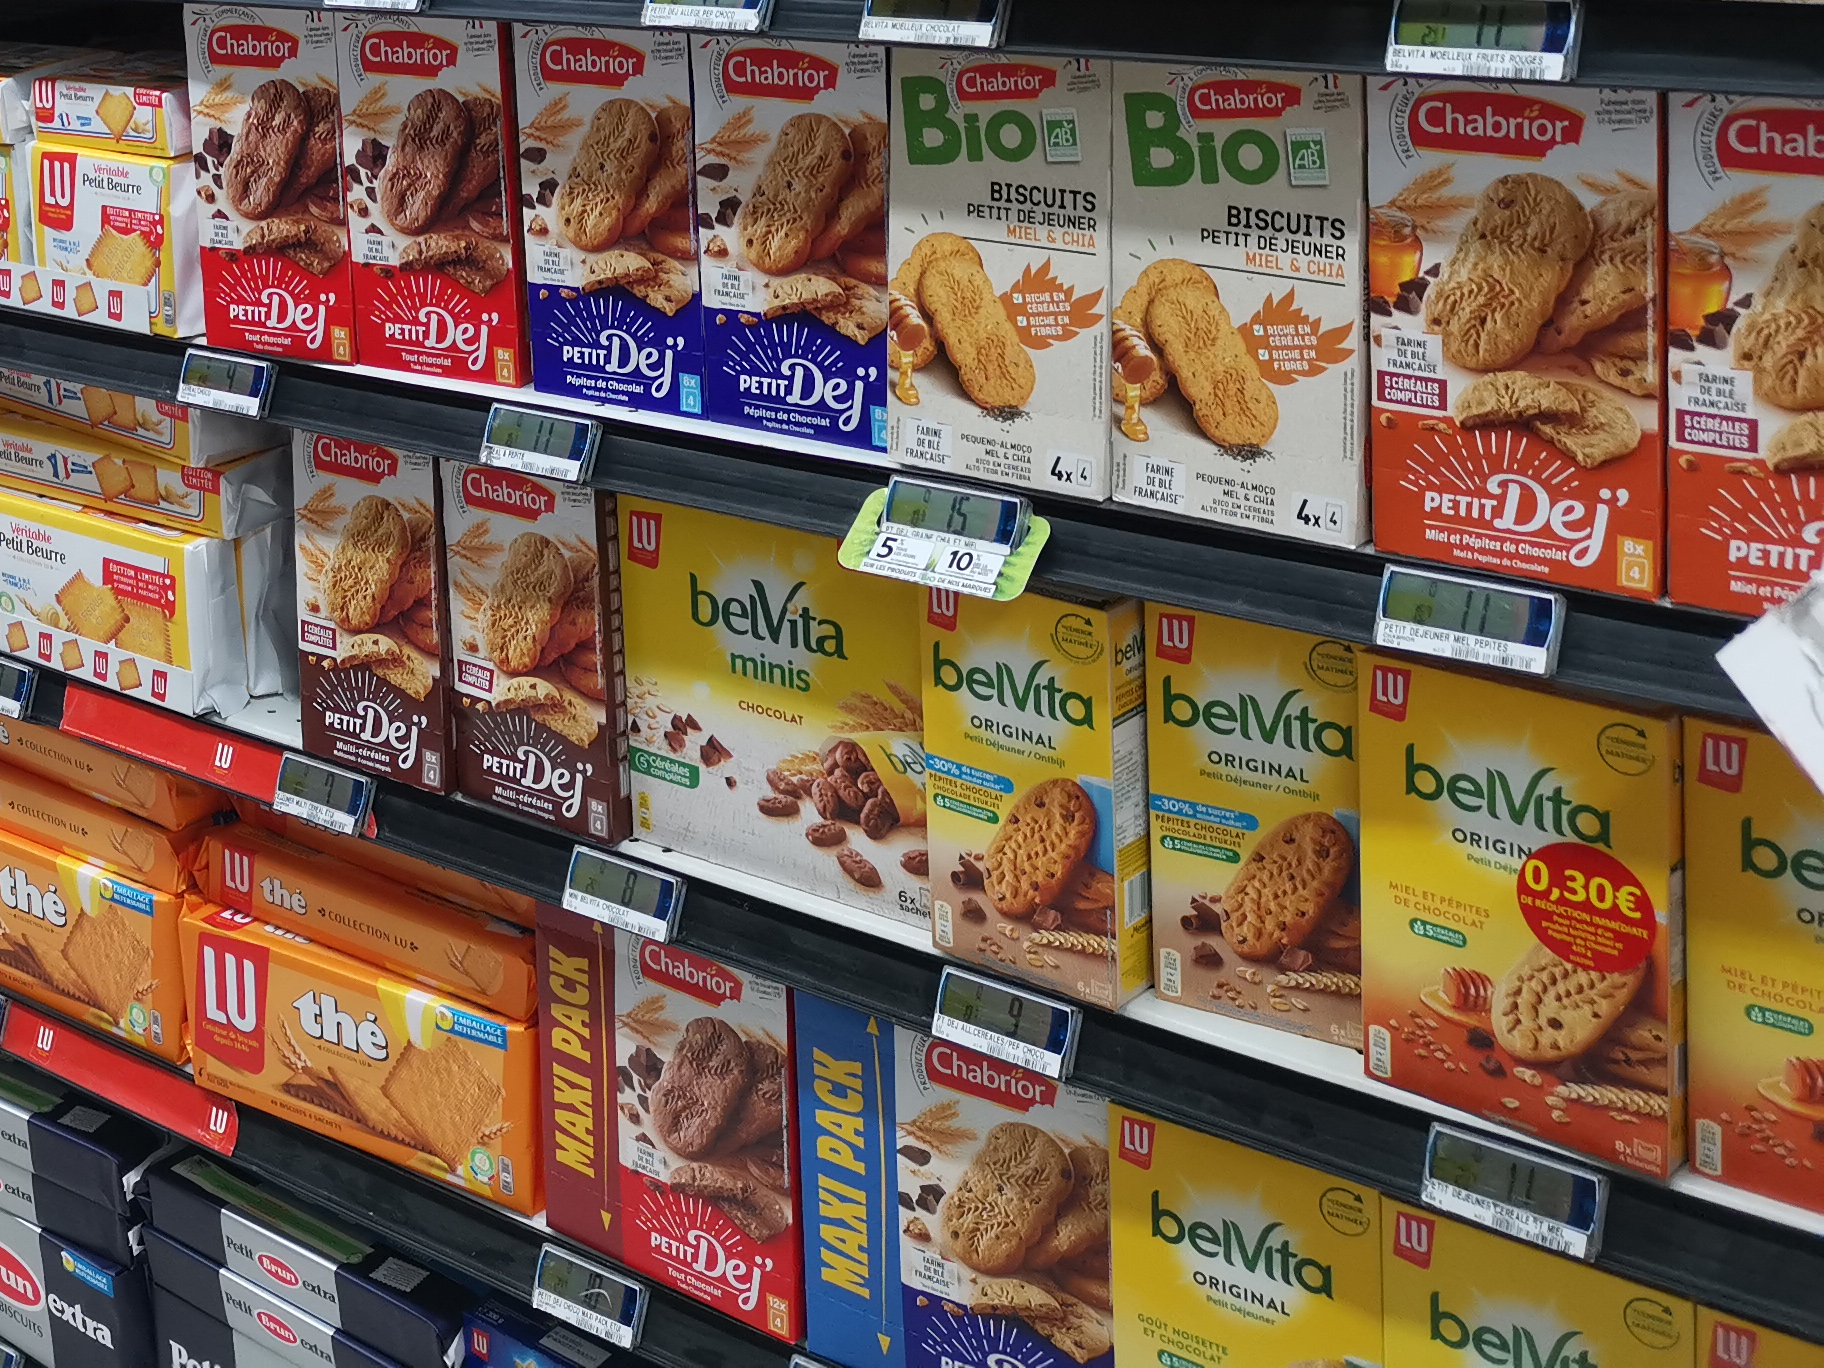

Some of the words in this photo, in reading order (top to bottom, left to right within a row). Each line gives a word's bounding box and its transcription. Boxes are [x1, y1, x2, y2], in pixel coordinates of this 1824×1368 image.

[212, 33, 291, 57] Chabrior
[1392, 48, 1426, 61] BELVITA
[1429, 50, 1473, 63] MOELLEUX
[1475, 52, 1504, 63] FRUITS
[1507, 53, 1544, 65] ROUGES
[728, 56, 828, 87] Chabrior
[1194, 88, 1285, 111] Chabrior
[1417, 101, 1569, 143] Chabrior
[82, 173, 106, 190] Petit
[109, 180, 142, 195] Beurre
[1227, 206, 1345, 239] BISCUITS
[1201, 228, 1251, 248] PETIT
[1258, 231, 1346, 261] DÉJEUNER
[1246, 250, 1285, 270] MIEL
[1290, 254, 1302, 272] &
[1308, 258, 1344, 279] CHIA
[230, 303, 267, 320] PETIT
[245, 333, 262, 342] Tout
[264, 335, 291, 345] chocolat
[740, 374, 788, 396] PETIT
[1384, 376, 1391, 390] 5
[1393, 378, 1439, 394] CÉRÉALES
[1384, 389, 1439, 407] COMPLÈTES
[744, 405, 776, 419] Pépites
[779, 410, 790, 421] de
[791, 412, 830, 427] Chocolat
[466, 477, 548, 512] Chabrior
[1424, 491, 1497, 517] PETIT
[632, 517, 656, 552] LU
[876, 538, 894, 559] 5
[949, 550, 973, 571] 10
[689, 572, 848, 661] belVita
[1162, 618, 1189, 648] LU
[1384, 622, 1407, 633] PETIT
[1409, 626, 1450, 641] DEJEUNER
[1453, 635, 1472, 645] MIEL
[1475, 638, 1508, 652] PEPITES
[730, 650, 811, 693] minis
[933, 640, 1096, 731] belVita
[1376, 671, 1404, 705] LU
[325, 710, 362, 732] PETIT
[738, 700, 804, 727] CHOCOLAT
[1163, 675, 1355, 761] belVita
[336, 741, 390, 762] Multi-céréales
[1207, 750, 1310, 784] ORIGINAL
[651, 758, 692, 779] Céréales
[1405, 742, 1613, 850] belVita
[1524, 857, 1642, 921] 0,30€
[328, 911, 390, 944] COLLECTION
[393, 937, 409, 949] LU
[204, 945, 255, 1032] LU
[645, 945, 734, 999] Chabrior
[550, 945, 591, 1066] PACK
[293, 989, 389, 1059] thé
[932, 1049, 1047, 1103] Chabrior
[553, 1060, 594, 1178] MAXI
[813, 1048, 864, 1175] PACK
[651, 1234, 695, 1263] PETIT
[819, 1179, 871, 1299] MAXI
[1151, 1189, 1334, 1300] belVita
[1193, 1271, 1290, 1317] ORIGINAL
[48, 1295, 113, 1348] extra
